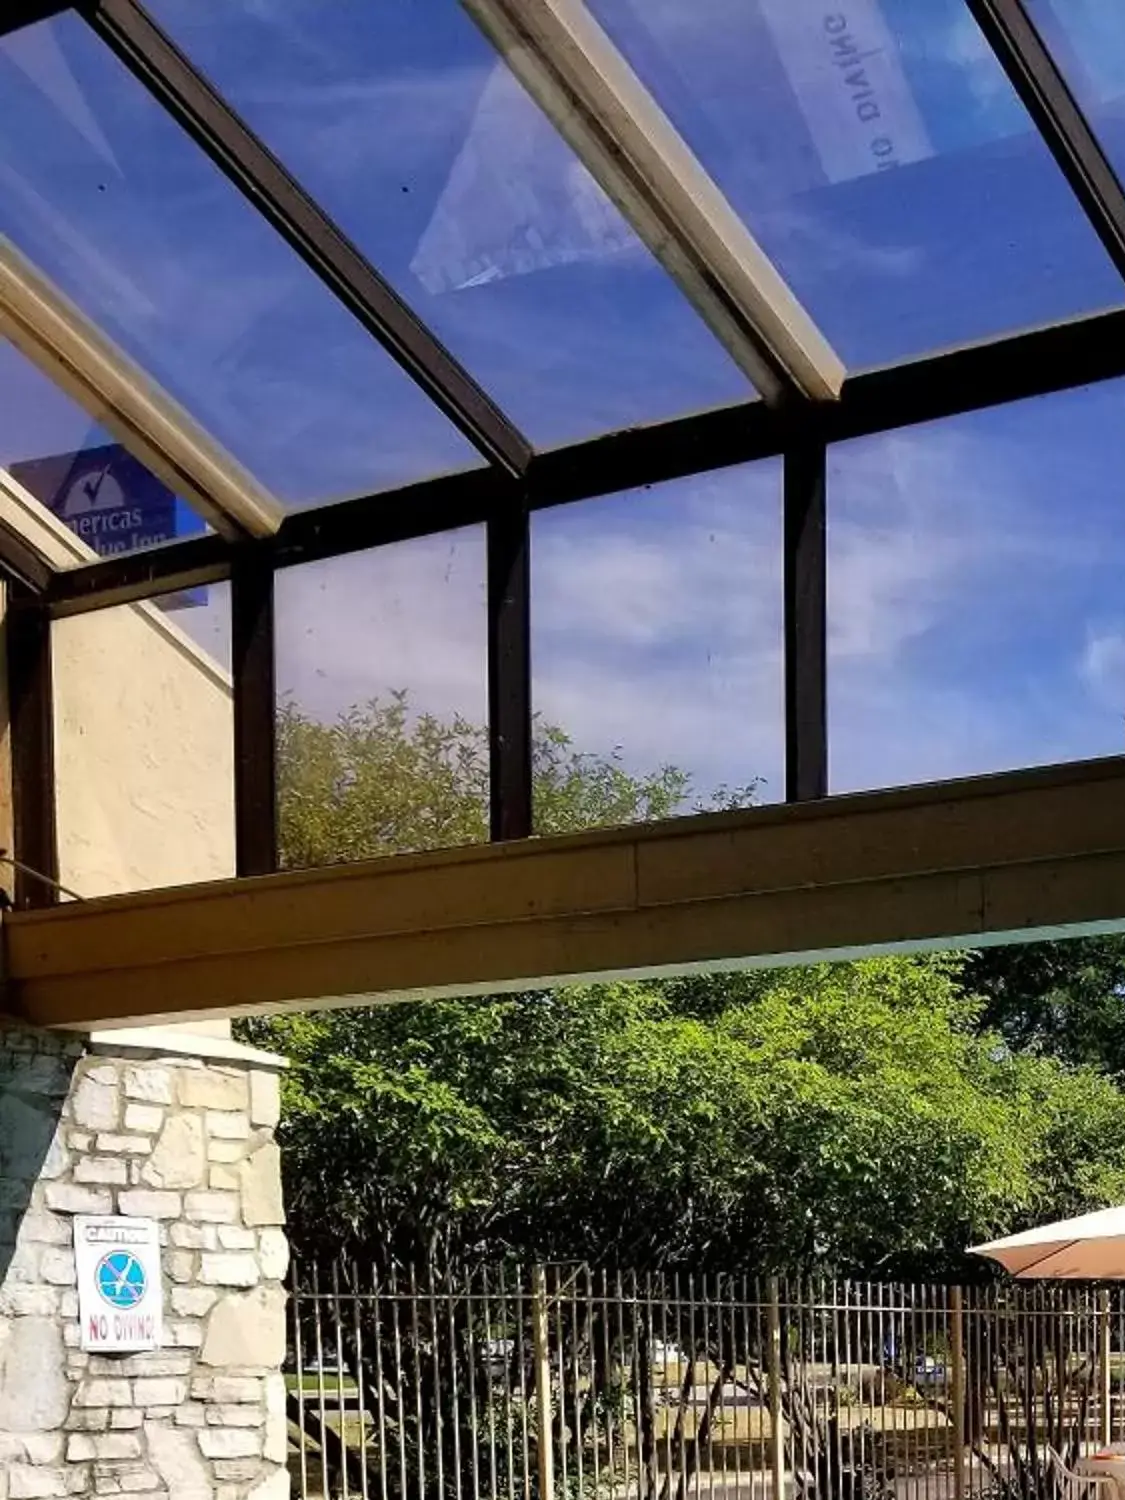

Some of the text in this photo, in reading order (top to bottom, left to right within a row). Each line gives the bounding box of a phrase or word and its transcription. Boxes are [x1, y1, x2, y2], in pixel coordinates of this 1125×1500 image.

[66, 508, 142, 535] ericas
[86, 1227, 146, 1242] CAUTIO
[89, 1314, 154, 1341] NO DIVING
